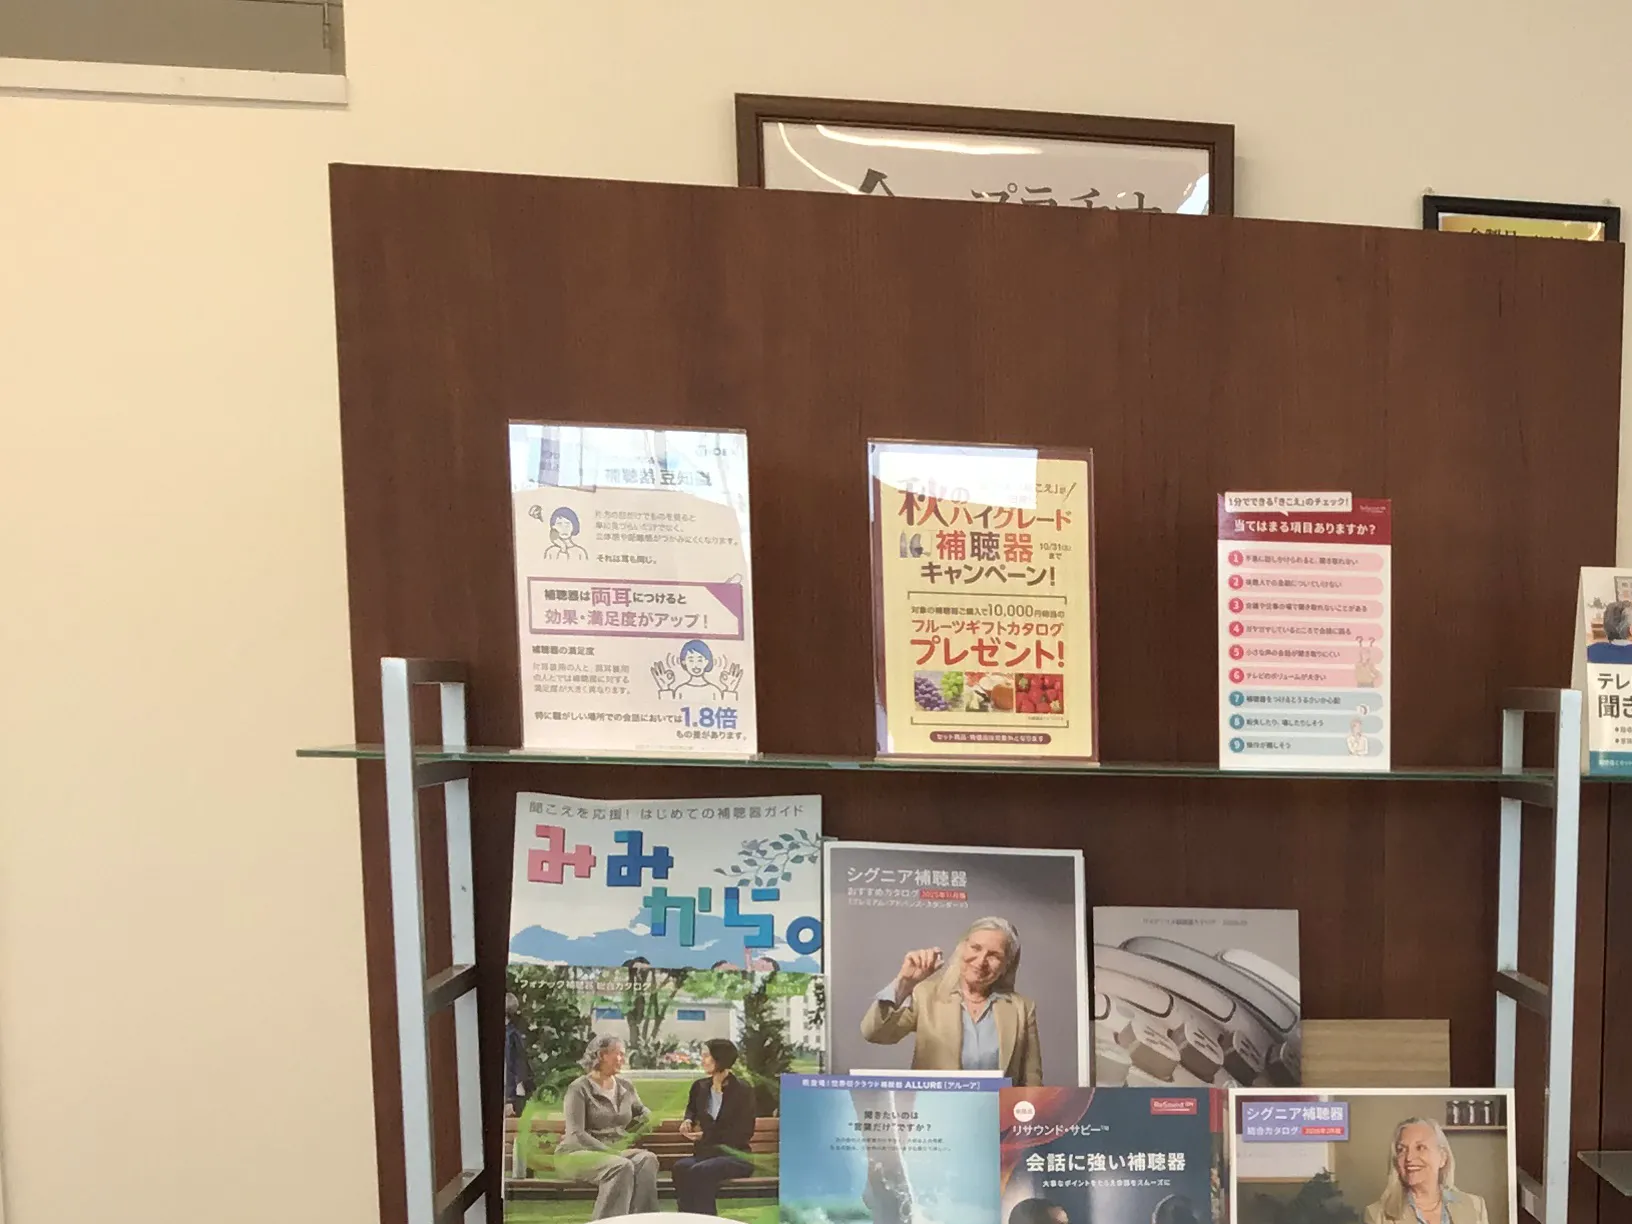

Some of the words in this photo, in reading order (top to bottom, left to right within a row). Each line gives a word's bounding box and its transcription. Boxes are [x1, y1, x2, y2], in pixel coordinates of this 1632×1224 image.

[949, 505, 1072, 531] ハイグレード
[1234, 519, 1376, 535] 当てはまる項目ありますか?
[935, 530, 1033, 563] 補聴器
[921, 562, 1056, 586] キャンペーン!
[544, 587, 687, 607] 補聴器は両耳につけると
[911, 620, 1064, 637] フルーツギフトカタログ
[910, 637, 1065, 669] プレゼント!
[527, 801, 630, 820] 聞こえを応援!
[640, 804, 804, 820] はじめての補聴器ガイド
[527, 824, 674, 887] みみ
[847, 867, 968, 888] シグニア補聴器
[847, 887, 919, 898] おすすめカタログ
[905, 1081, 942, 1090] ALLURE
[864, 1111, 919, 1120] 聞きたいのは
[1247, 1106, 1343, 1121] シグニア補聴器
[1247, 1125, 1300, 1136] 総合カタログ
[1026, 1153, 1186, 1172] 会話に強い補聴器
